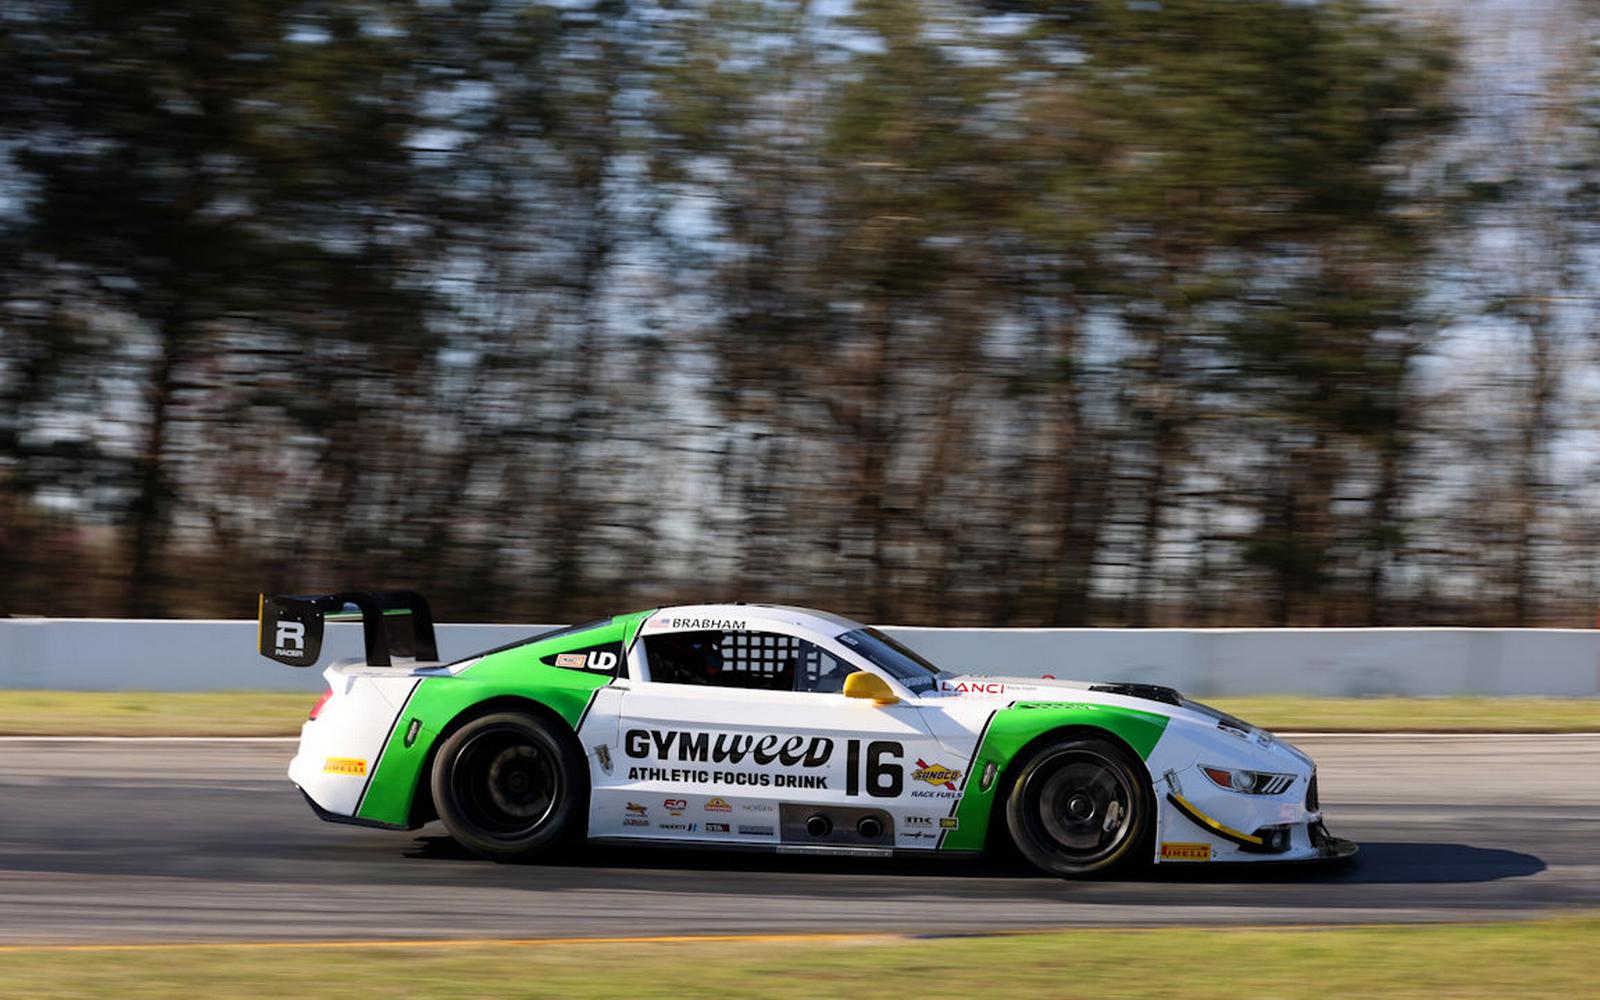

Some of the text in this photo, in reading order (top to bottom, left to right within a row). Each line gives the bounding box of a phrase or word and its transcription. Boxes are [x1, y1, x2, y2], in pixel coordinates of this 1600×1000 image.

[672, 618, 746, 629] BRABHAM
[275, 621, 305, 649] R
[275, 648, 304, 658] RACER
[941, 682, 1005, 694] LANCI
[846, 739, 905, 798] 16
[628, 766, 828, 790] ATHLETIC FOCUS DRINK
[915, 770, 960, 781] SUNOCO
[910, 790, 963, 799] RACE FUELS
[1161, 844, 1209, 858] PIRELLI
